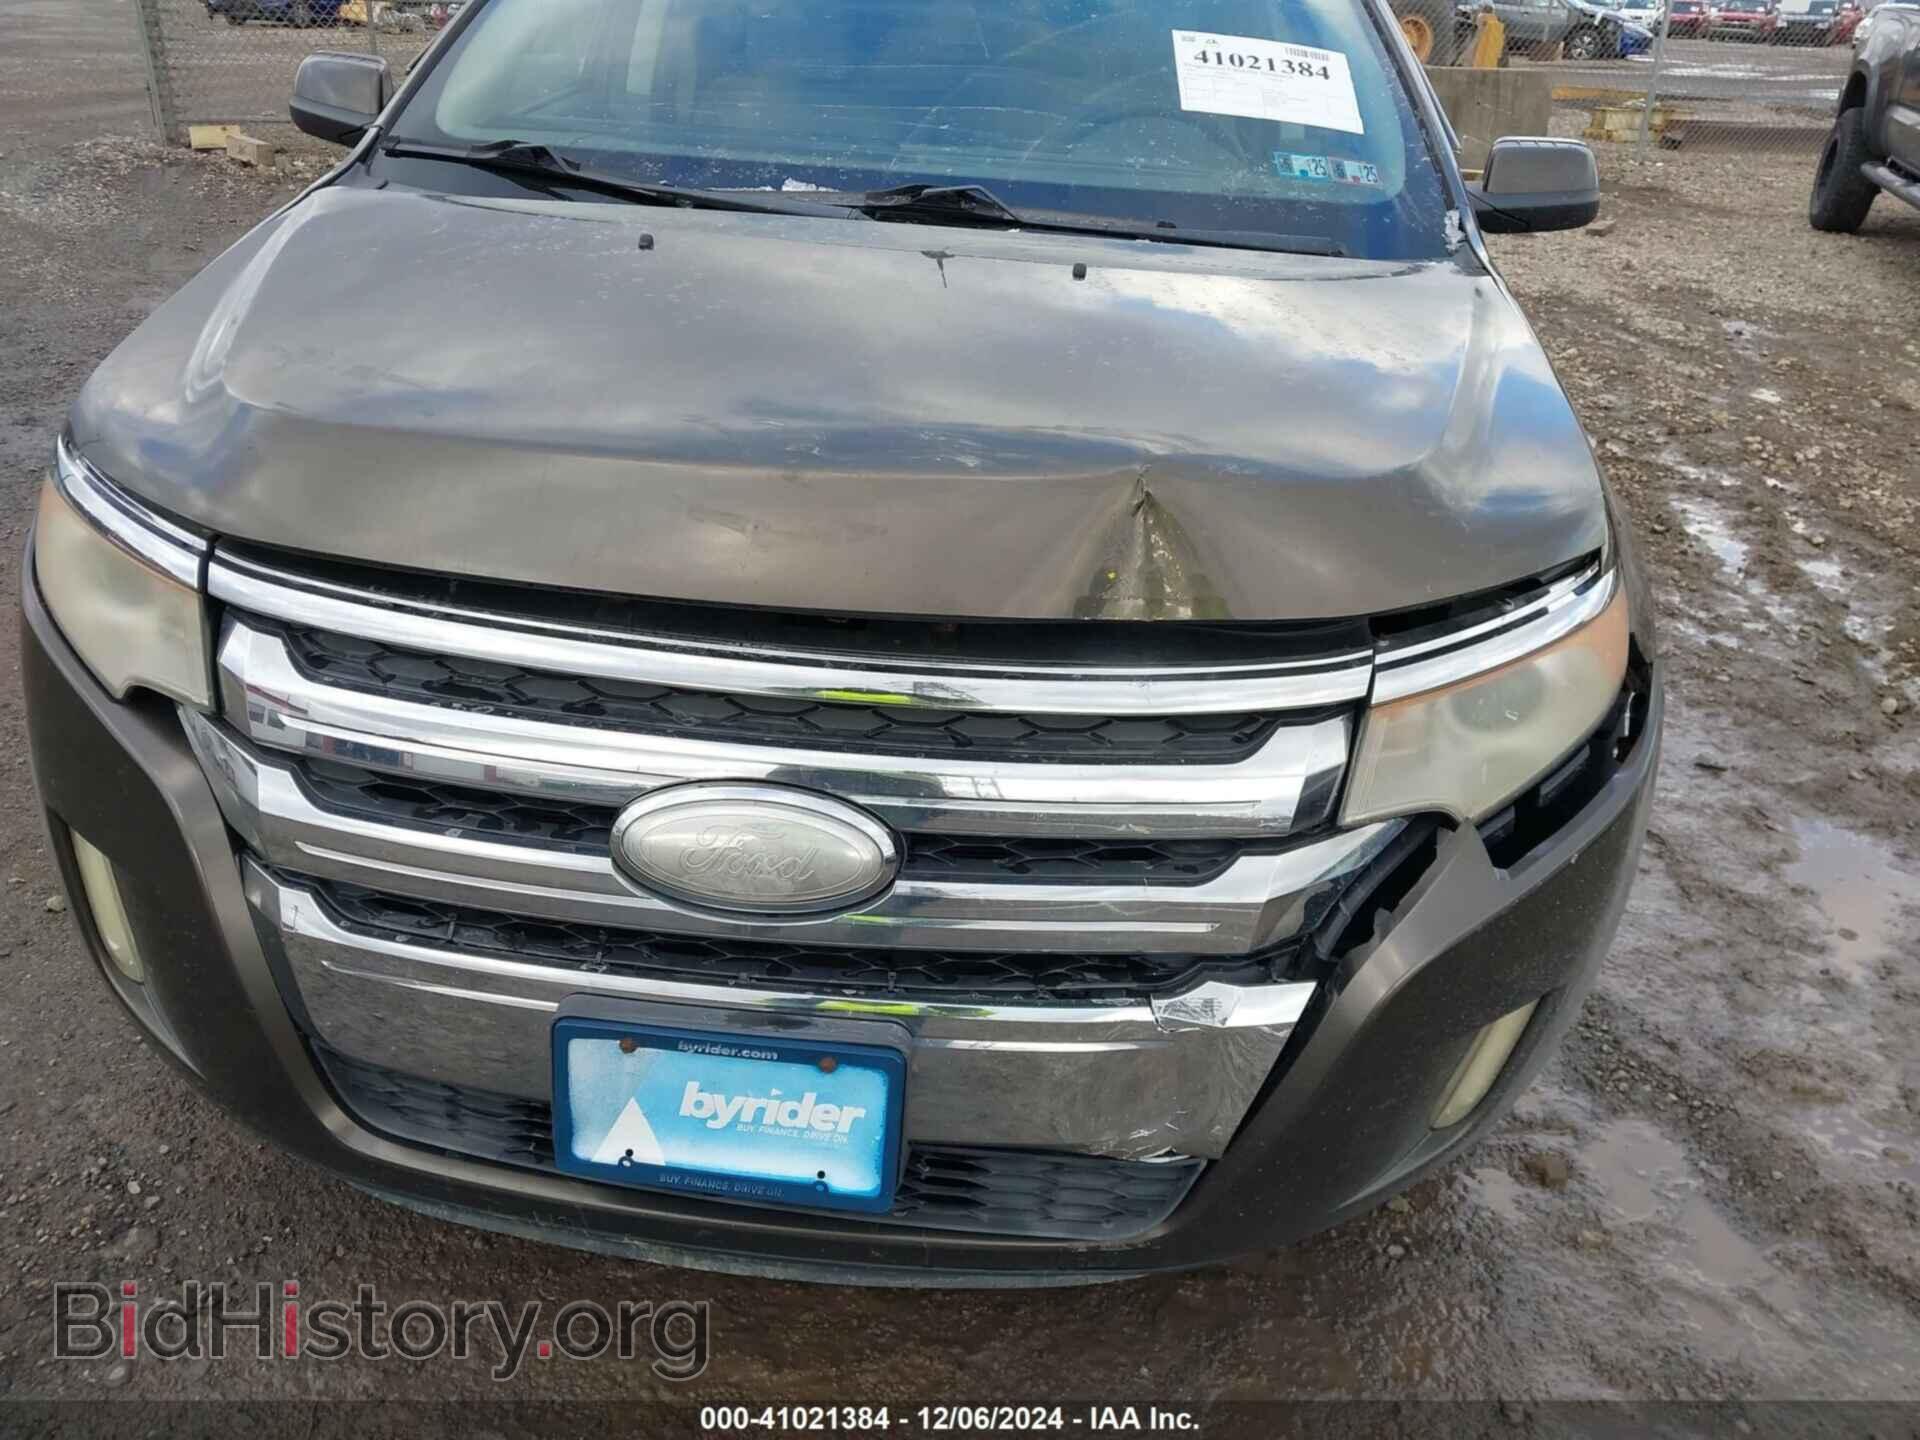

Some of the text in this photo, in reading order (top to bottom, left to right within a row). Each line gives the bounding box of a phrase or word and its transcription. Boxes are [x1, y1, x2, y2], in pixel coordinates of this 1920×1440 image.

[1194, 50, 1331, 81] 41021384
[680, 825, 821, 882] Ford
[678, 1040, 778, 1060] byrider.com
[679, 1081, 867, 1133] byrider
